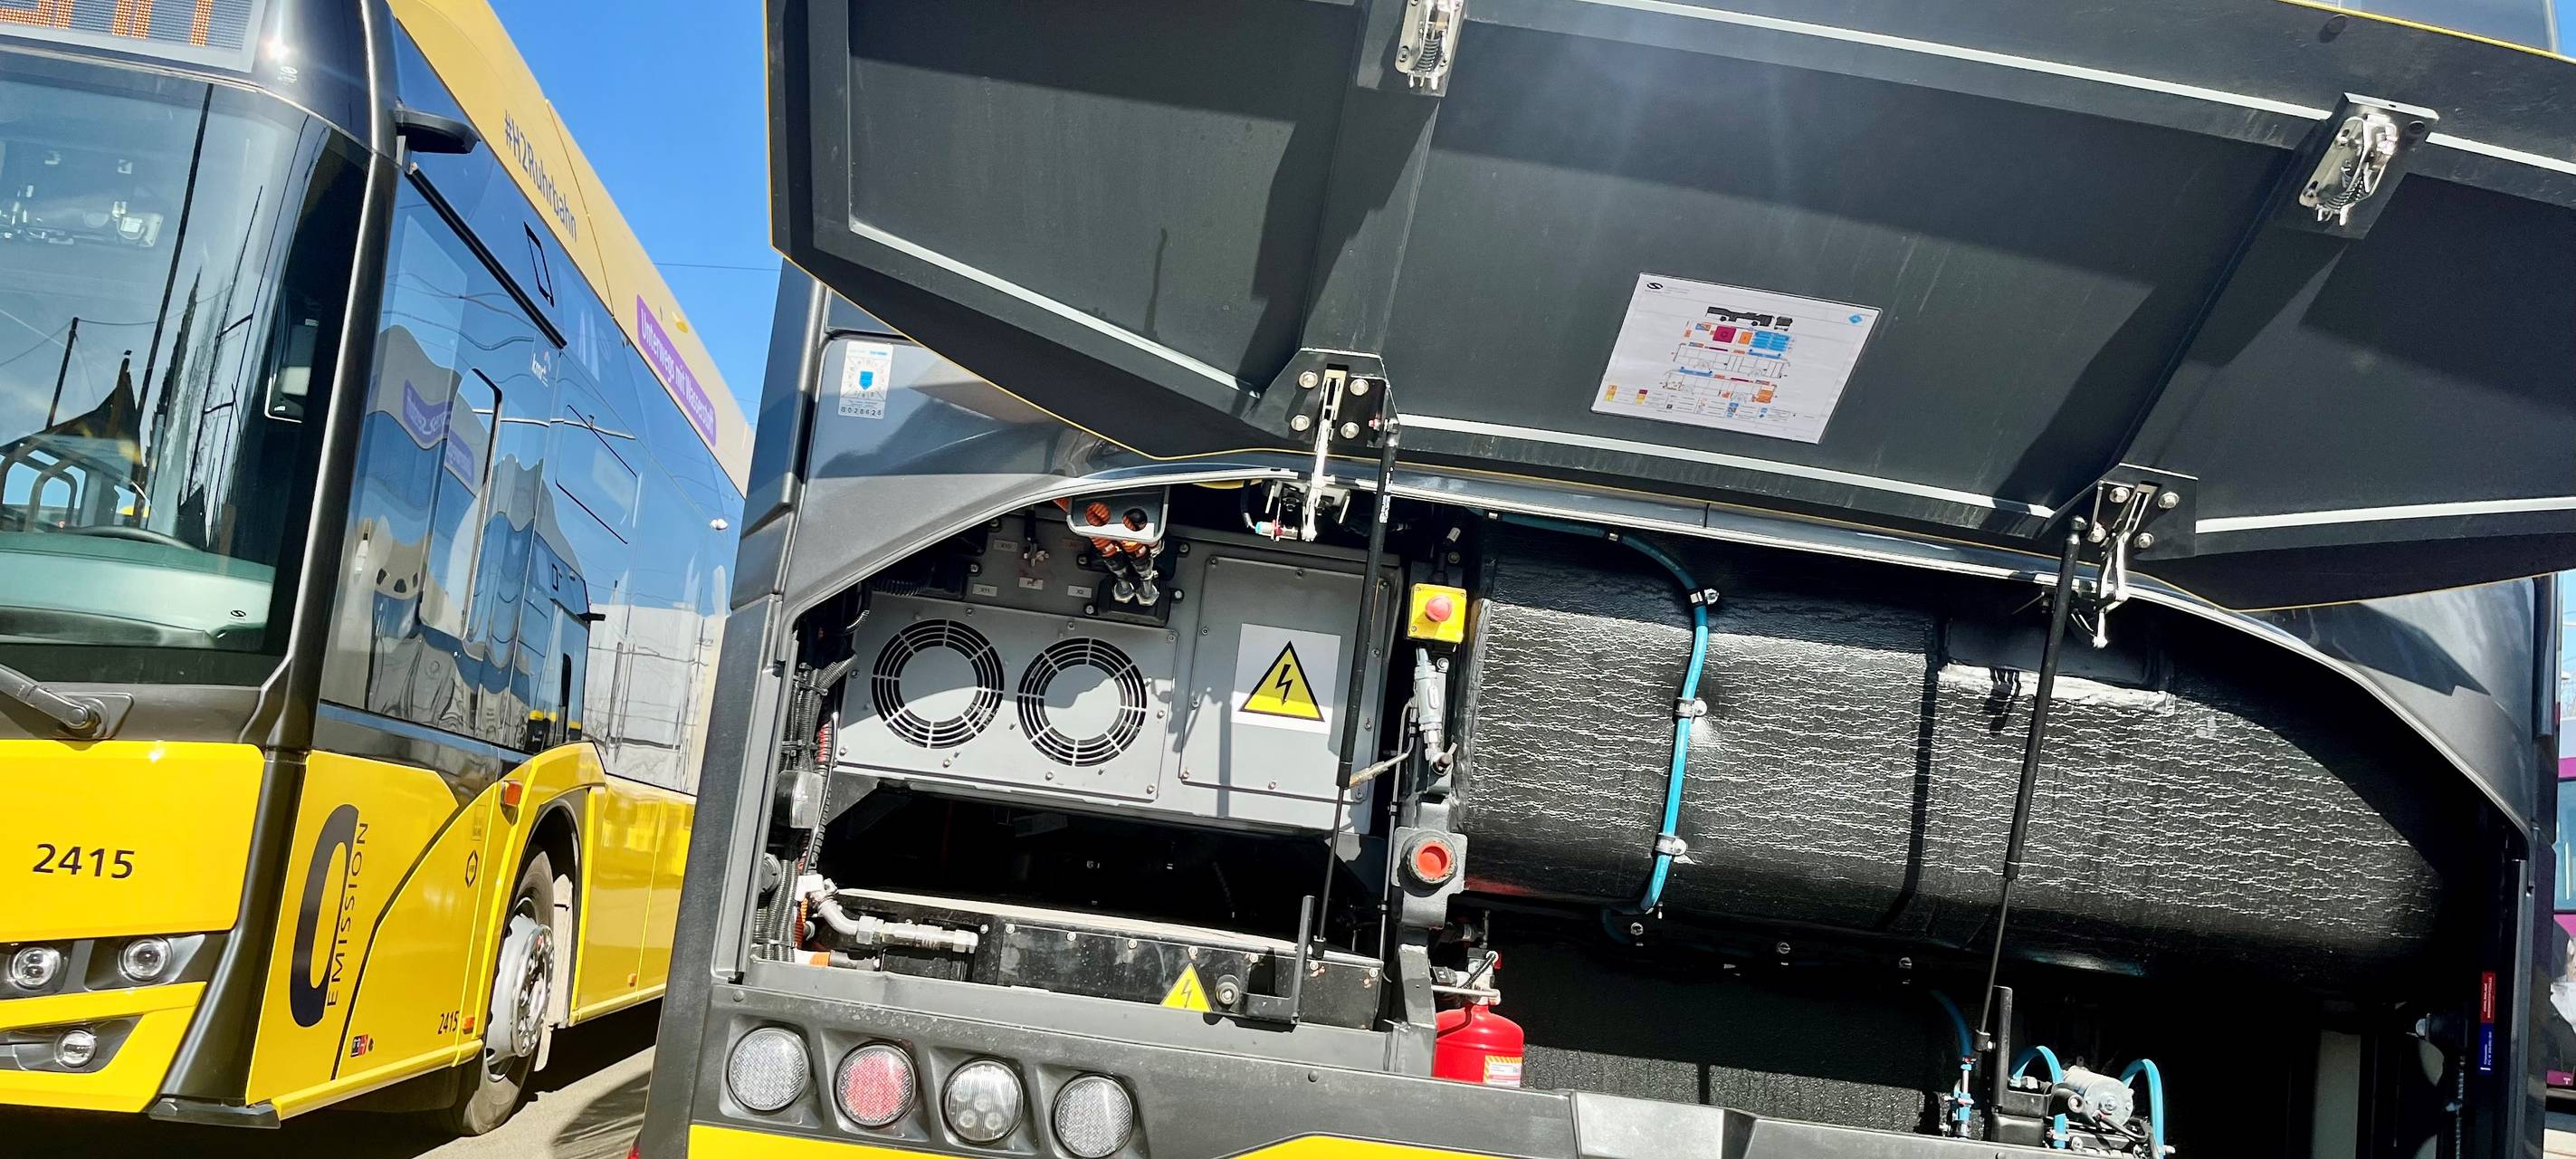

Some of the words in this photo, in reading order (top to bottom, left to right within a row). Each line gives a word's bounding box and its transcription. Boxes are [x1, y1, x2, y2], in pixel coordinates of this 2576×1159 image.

[504, 110, 577, 243] #H2Ruhrbahn
[640, 308, 675, 384] Unterwegs
[674, 361, 685, 395] mit
[684, 372, 714, 436] Wasserstoff
[33, 843, 135, 879] 2415
[327, 822, 369, 1006] EMISSION
[437, 1011, 460, 1035] 2415
